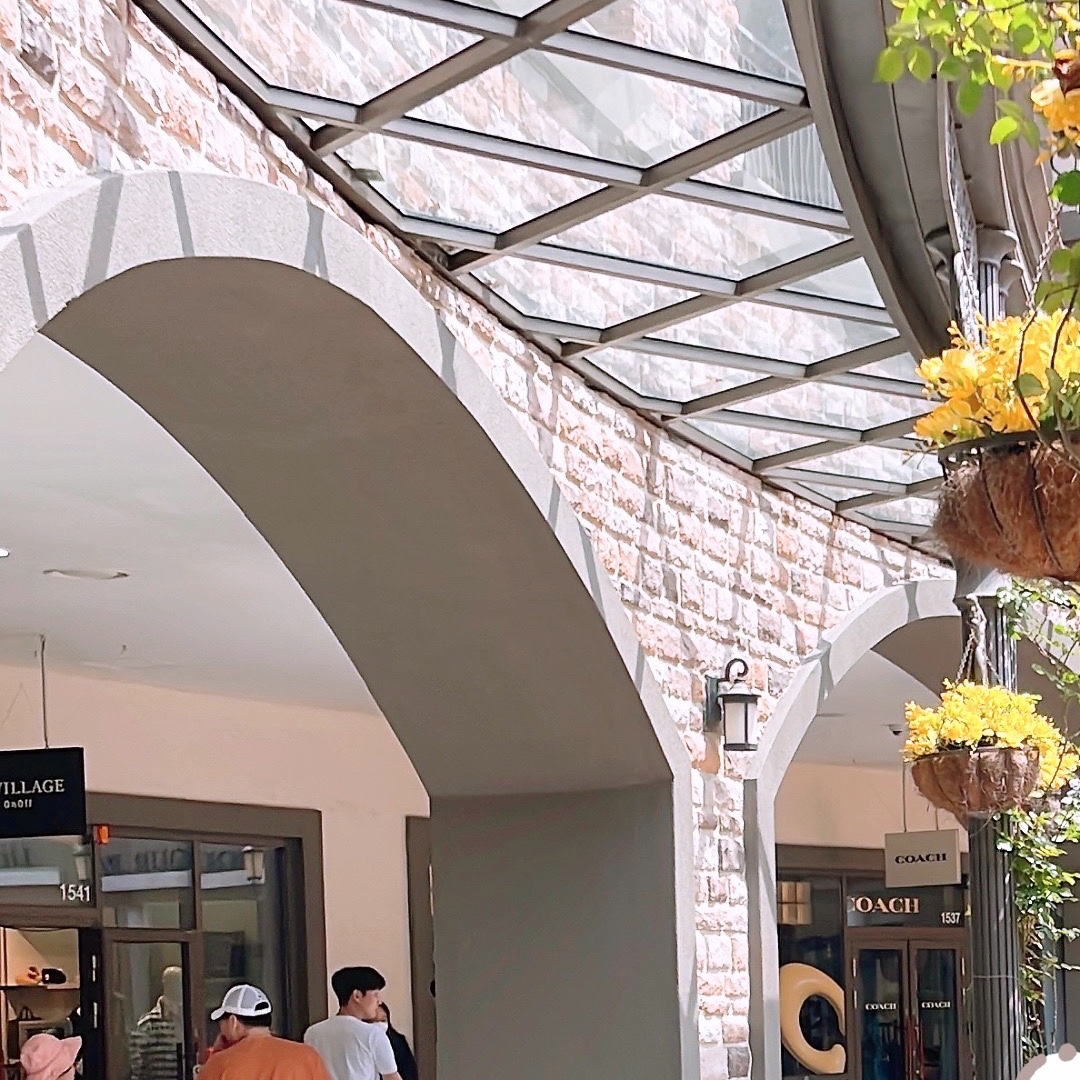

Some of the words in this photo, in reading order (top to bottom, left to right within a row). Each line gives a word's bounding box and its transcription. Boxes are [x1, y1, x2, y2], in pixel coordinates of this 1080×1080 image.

[895, 853, 947, 865] COACH
[60, 883, 91, 902] 1541
[941, 912, 961, 925] 1537
[865, 1002, 897, 1011] COACH
[921, 1001, 951, 1009] COACH
